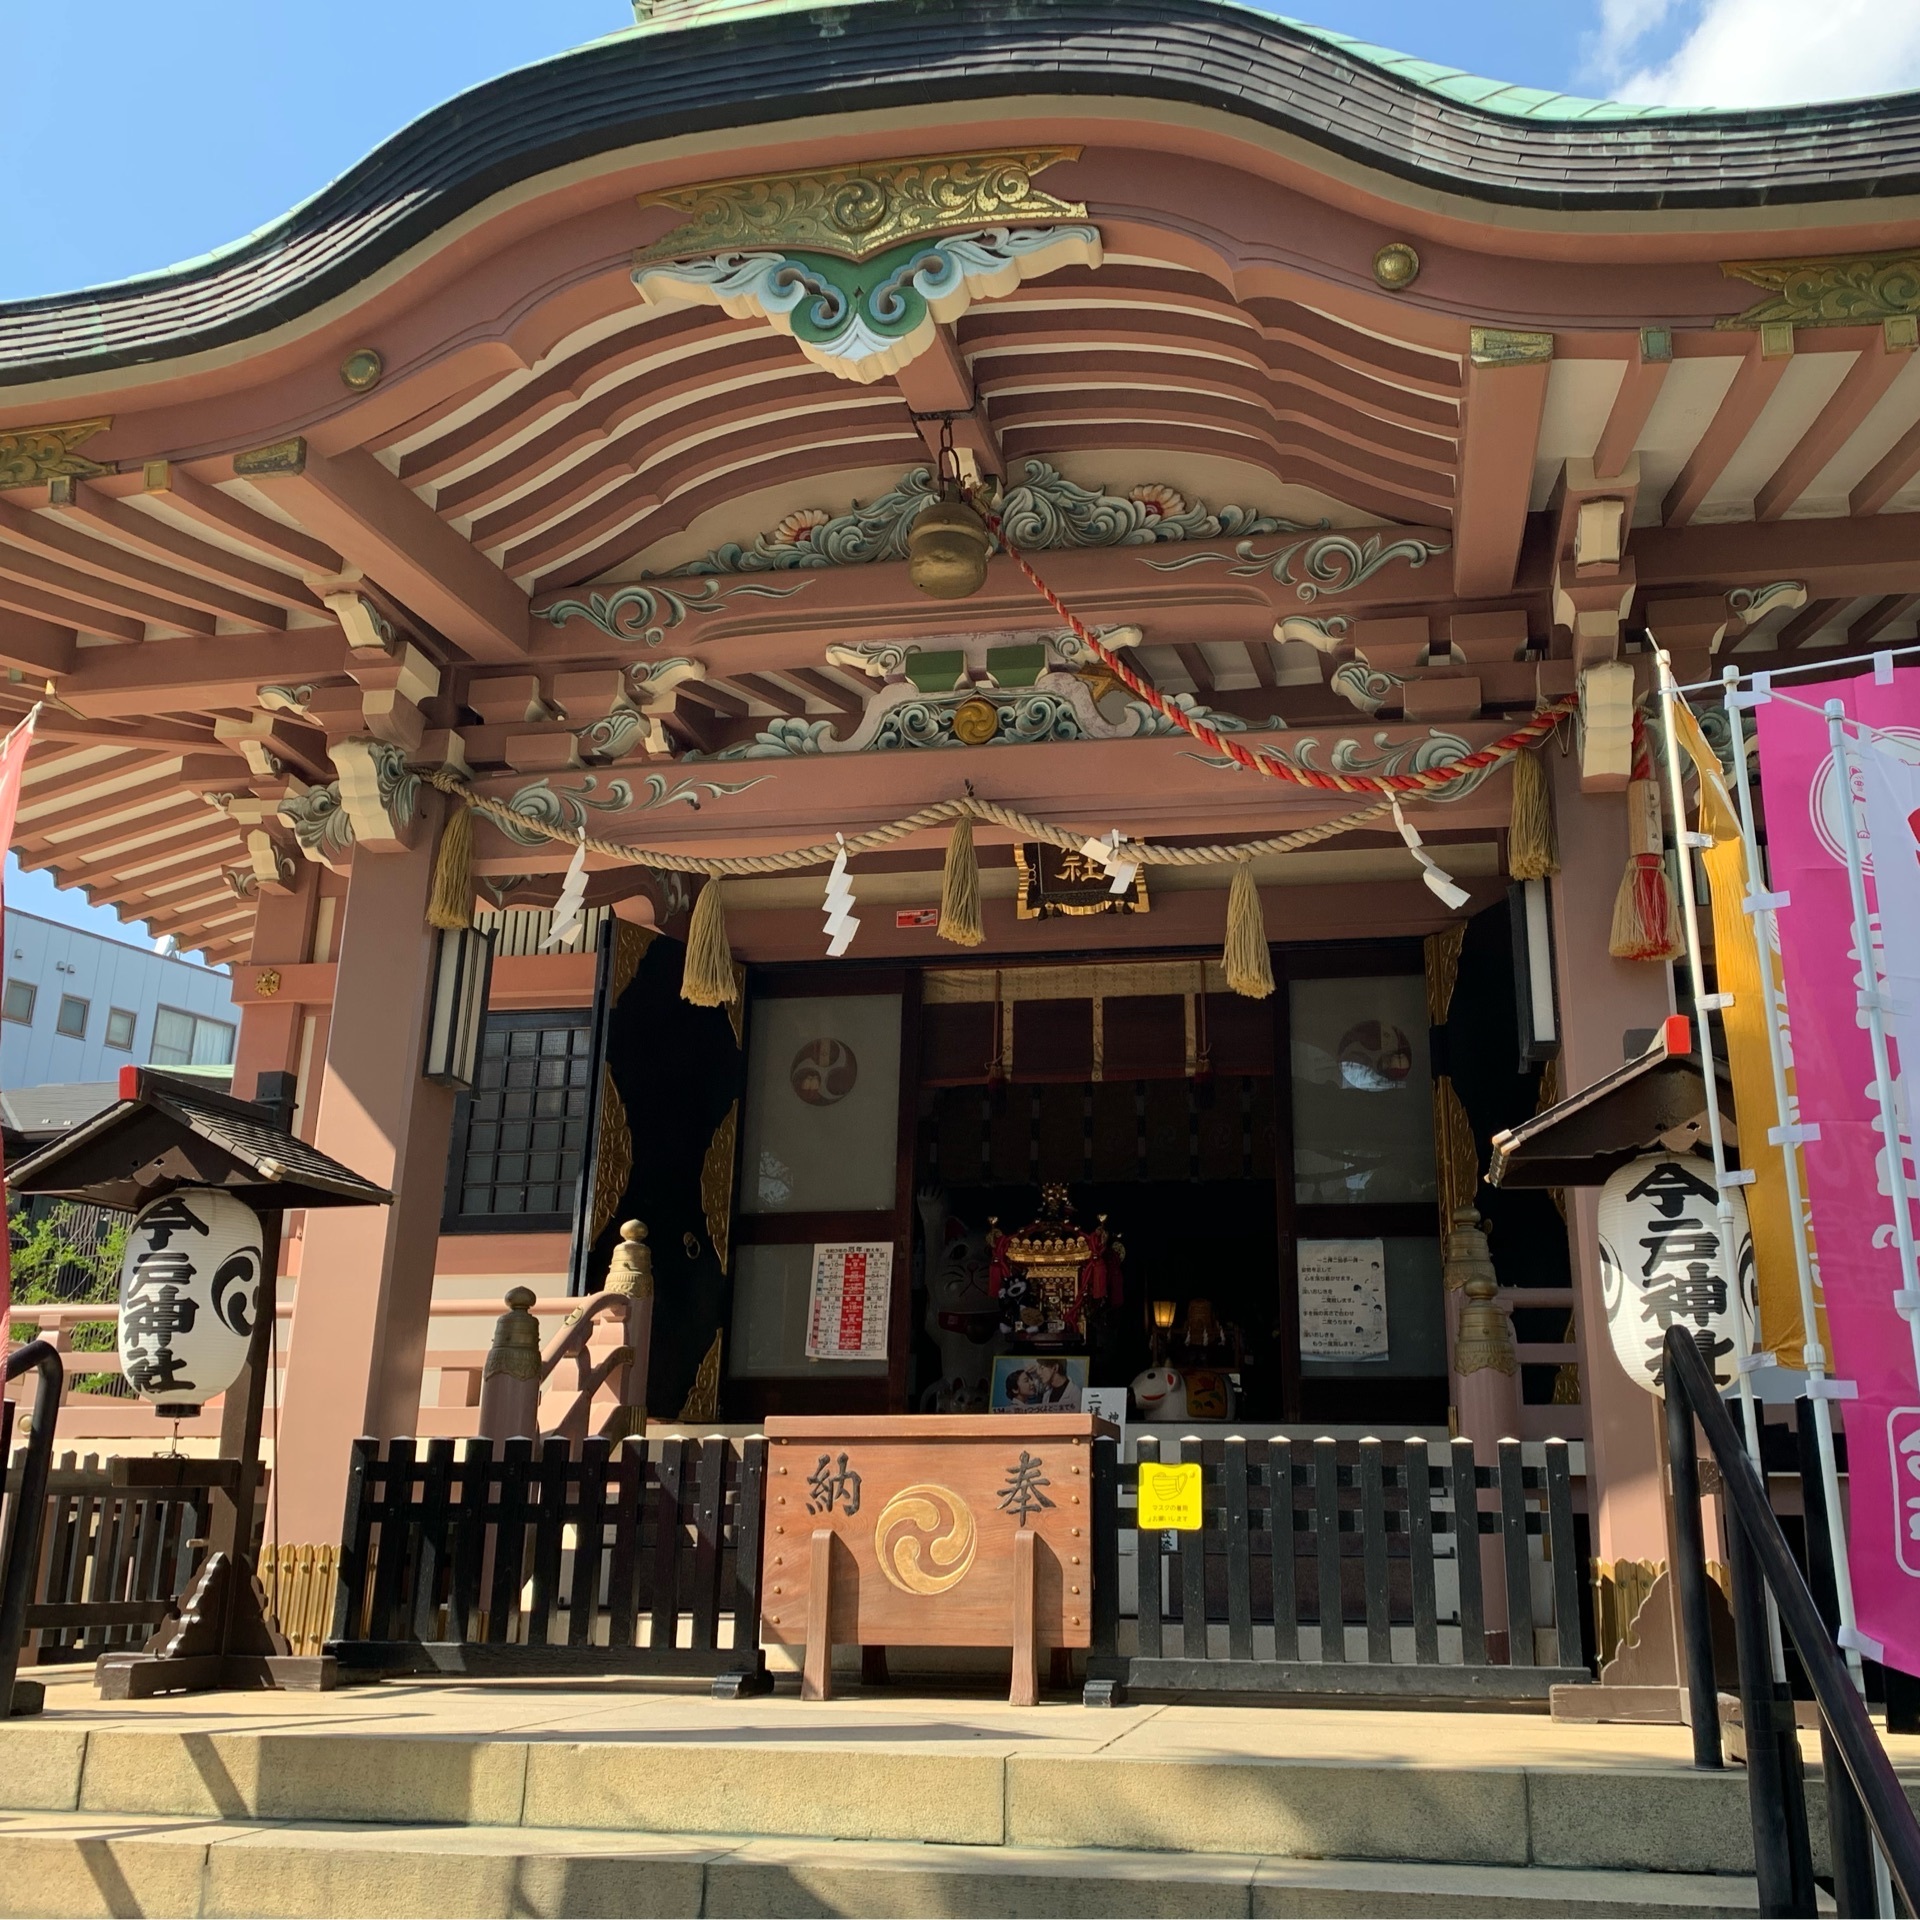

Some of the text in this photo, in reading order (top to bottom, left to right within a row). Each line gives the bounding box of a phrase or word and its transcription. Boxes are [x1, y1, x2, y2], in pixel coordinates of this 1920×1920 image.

[1054, 848, 1106, 882] 社
[123, 1198, 209, 1393] 今戸神社
[806, 1451, 1057, 1527] 奉 納
